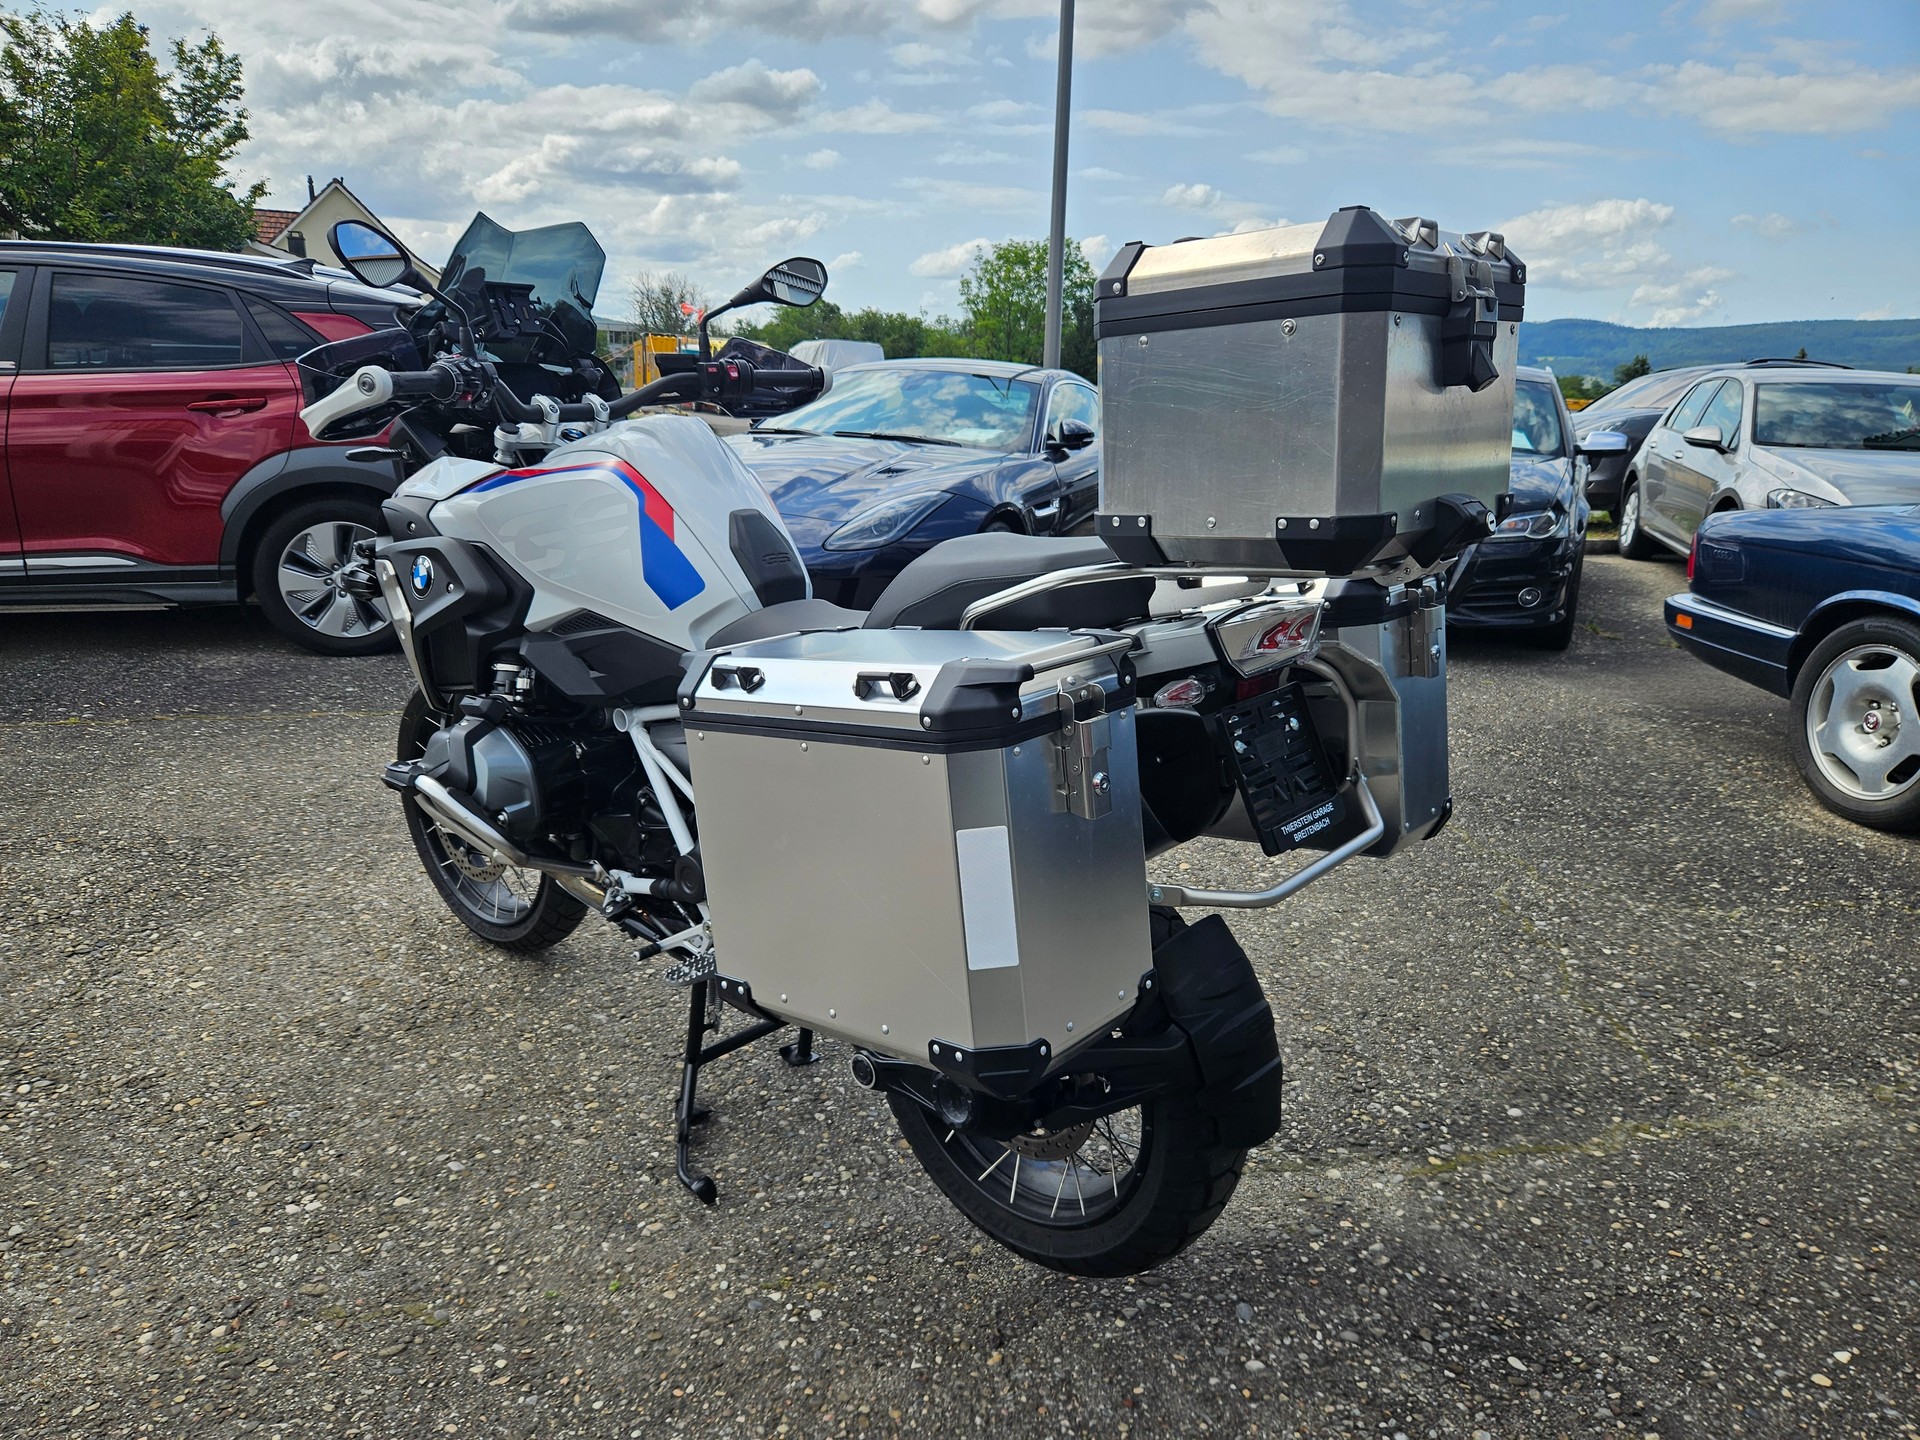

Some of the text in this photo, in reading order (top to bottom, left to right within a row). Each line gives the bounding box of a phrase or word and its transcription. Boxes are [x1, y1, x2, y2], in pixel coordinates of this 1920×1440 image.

[1281, 802, 1334, 835] THIERSTEIN GARAGE
[1293, 817, 1330, 842] BREITENBACH
